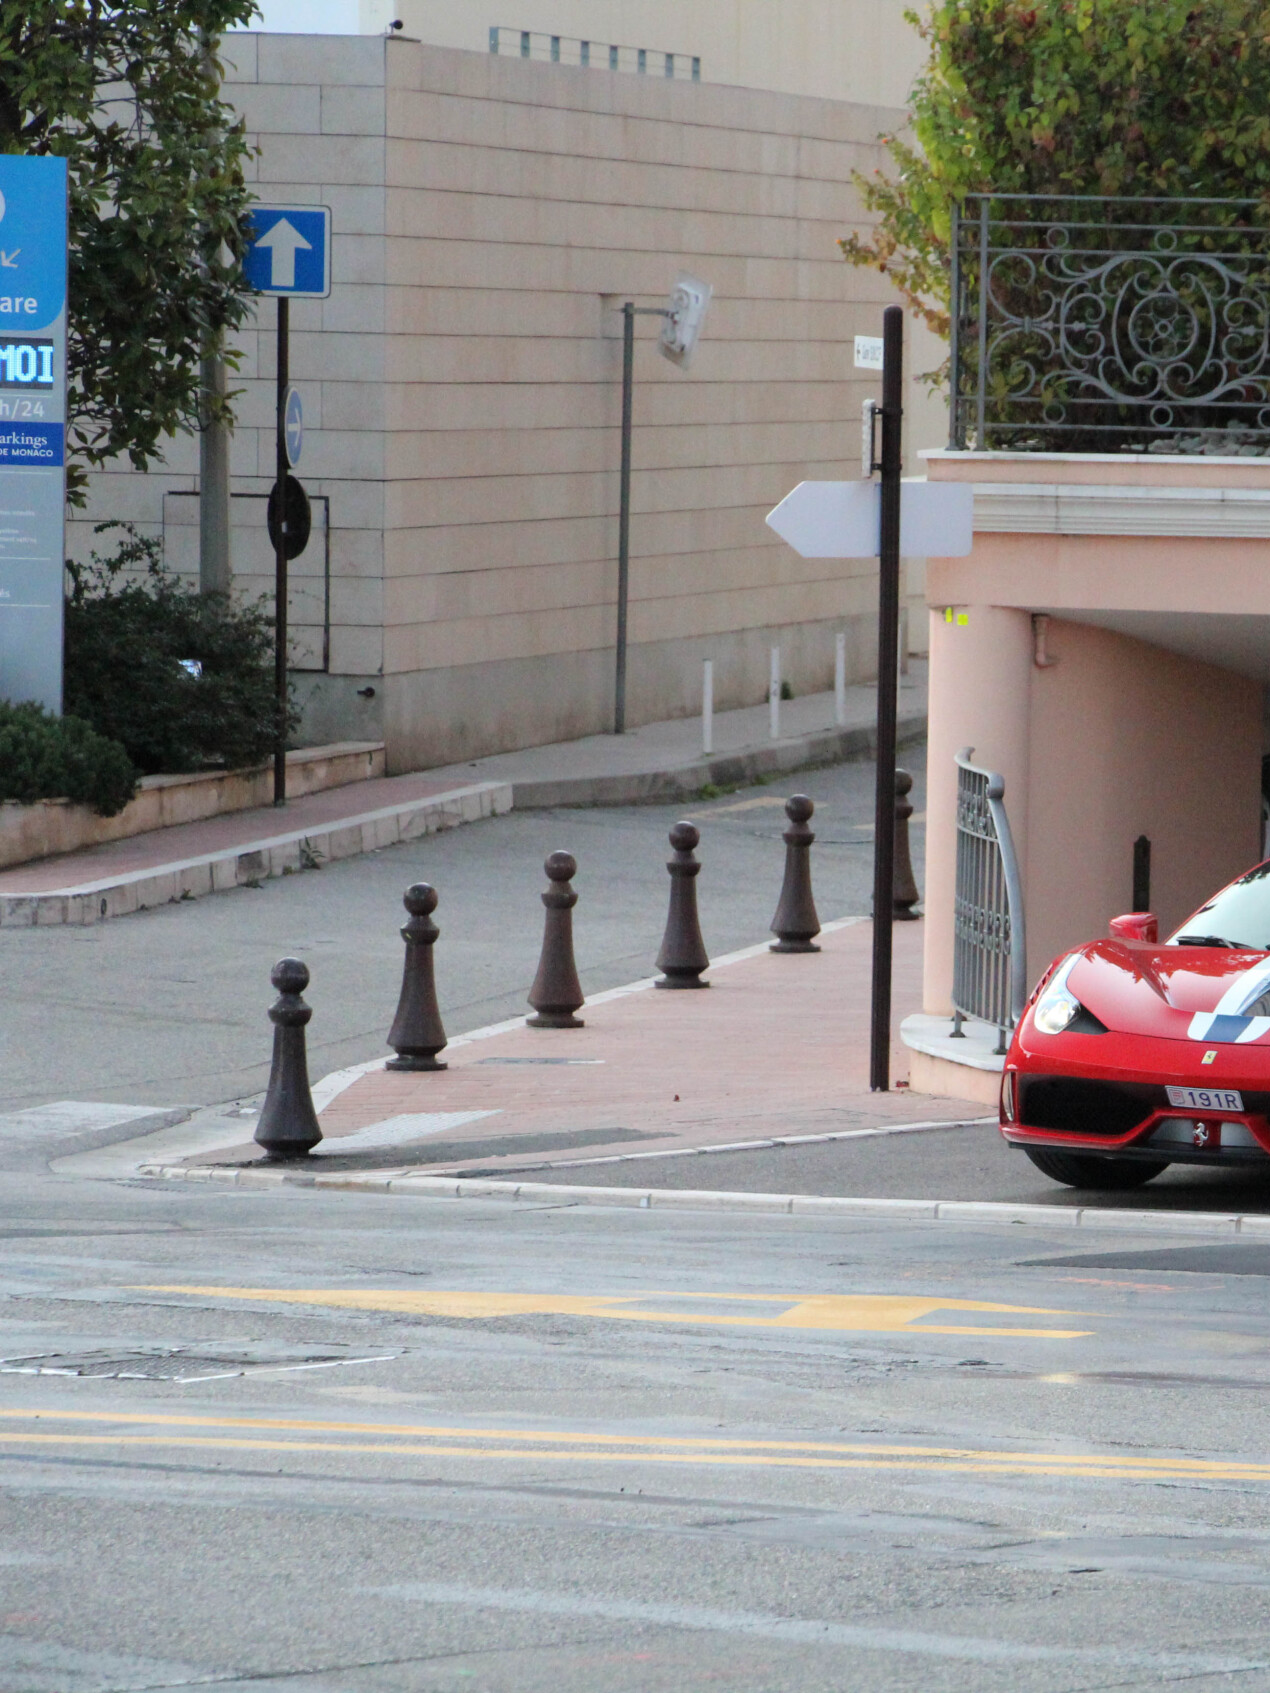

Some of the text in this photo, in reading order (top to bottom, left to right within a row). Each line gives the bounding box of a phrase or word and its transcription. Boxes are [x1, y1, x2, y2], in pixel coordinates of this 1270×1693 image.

[0, 432, 48, 449] arkings
[12, 448, 54, 457] MONACO
[1188, 1091, 1239, 1109] 191R
